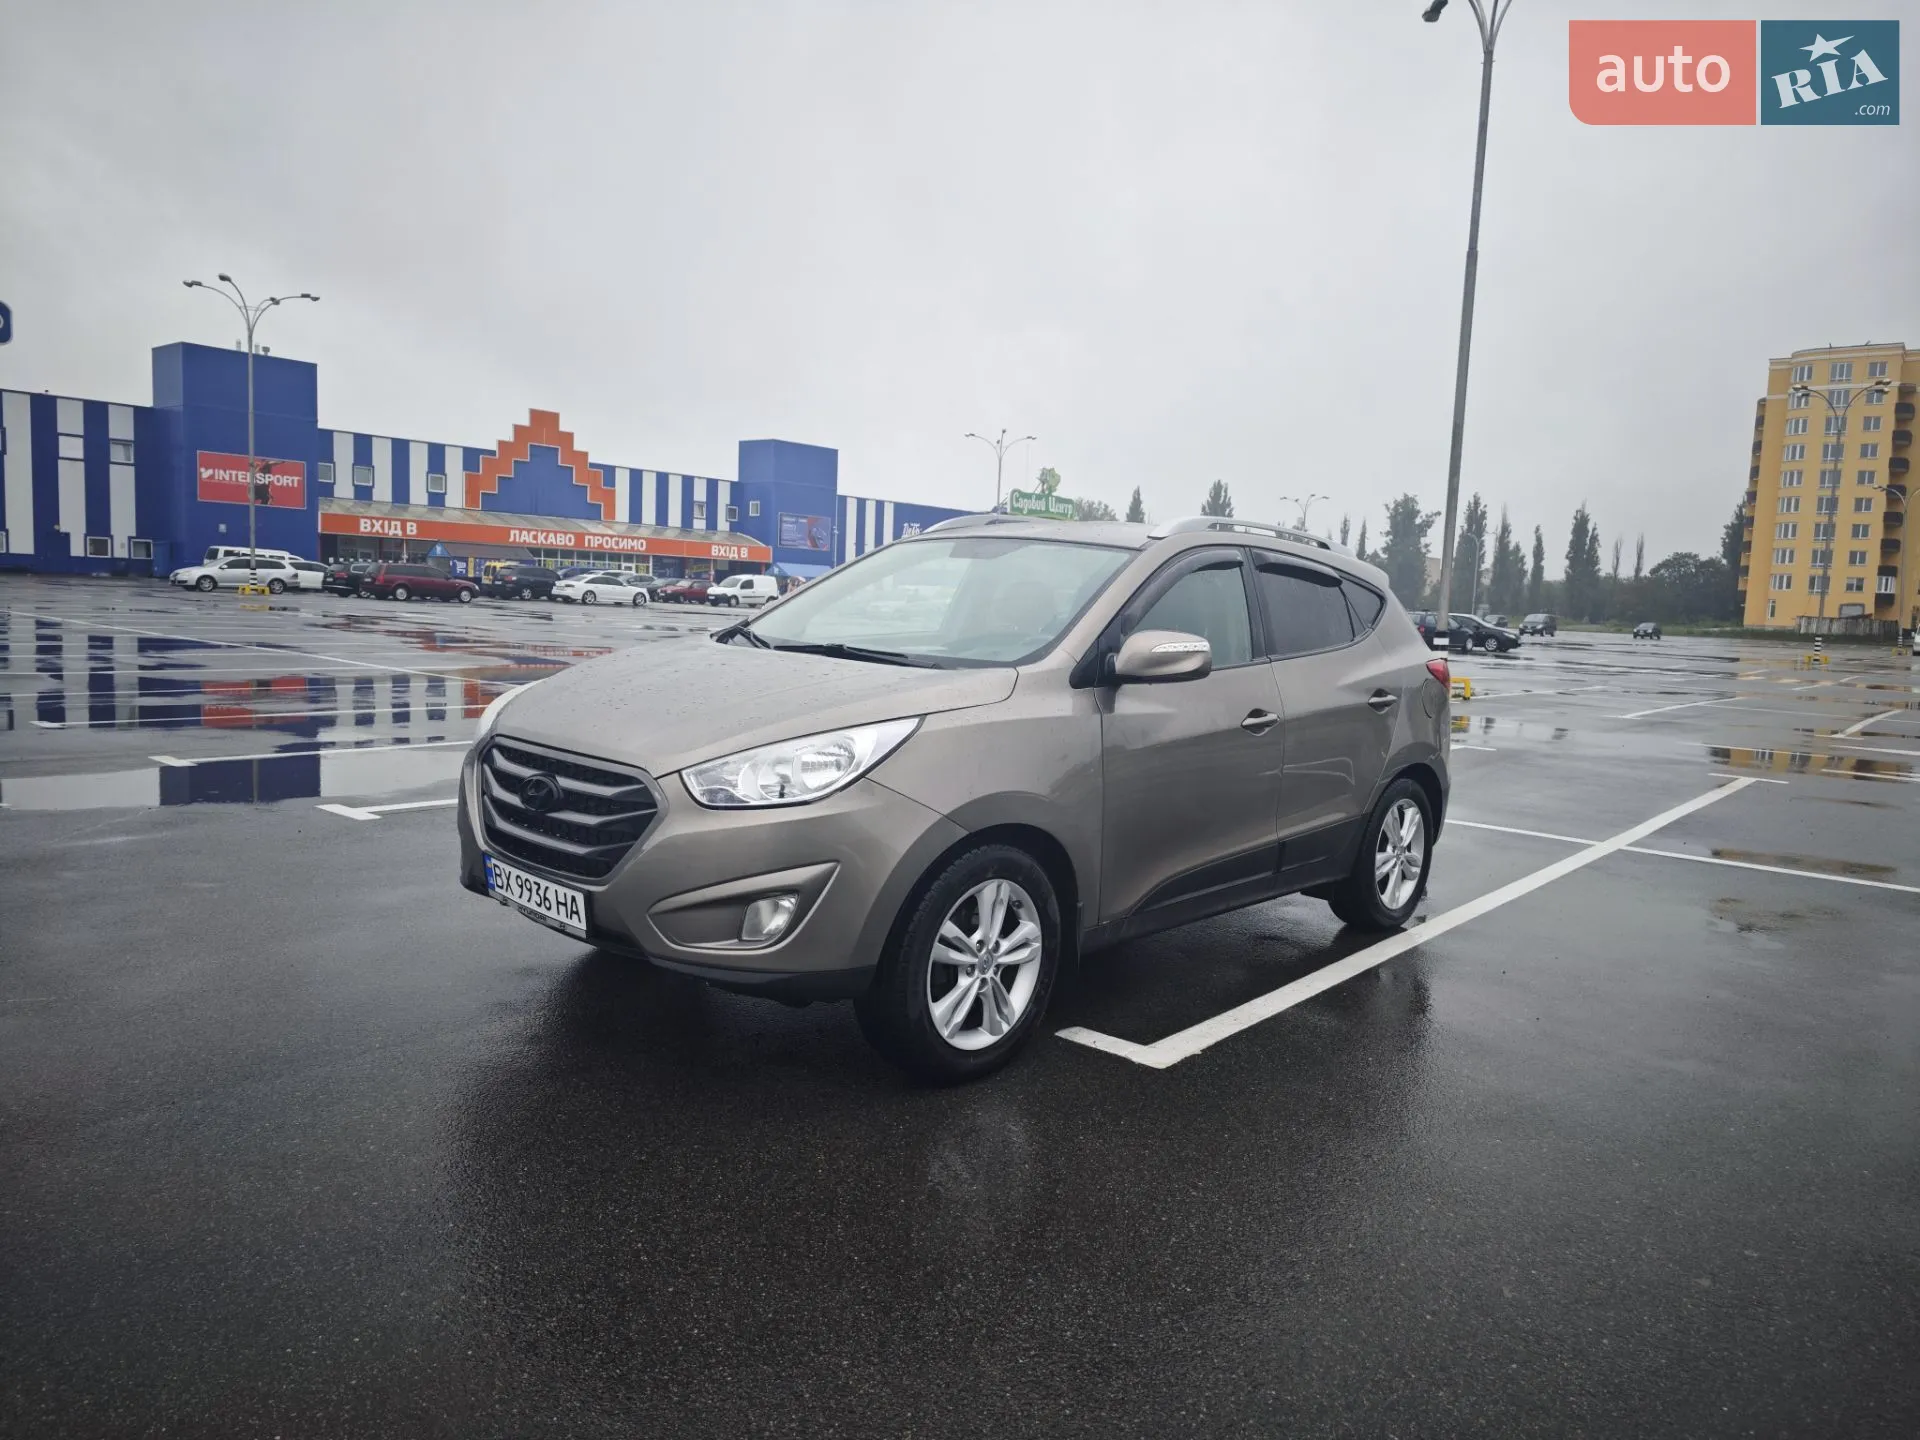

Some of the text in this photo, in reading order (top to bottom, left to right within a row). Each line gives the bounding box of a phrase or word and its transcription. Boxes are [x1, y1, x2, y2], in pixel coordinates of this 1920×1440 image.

[360, 518, 417, 536] ВХІД В
[509, 529, 647, 551] ЛАСКАВО ПРОСИМО
[711, 544, 738, 559] ВХІД
[493, 863, 582, 923] BX 9936 HA
